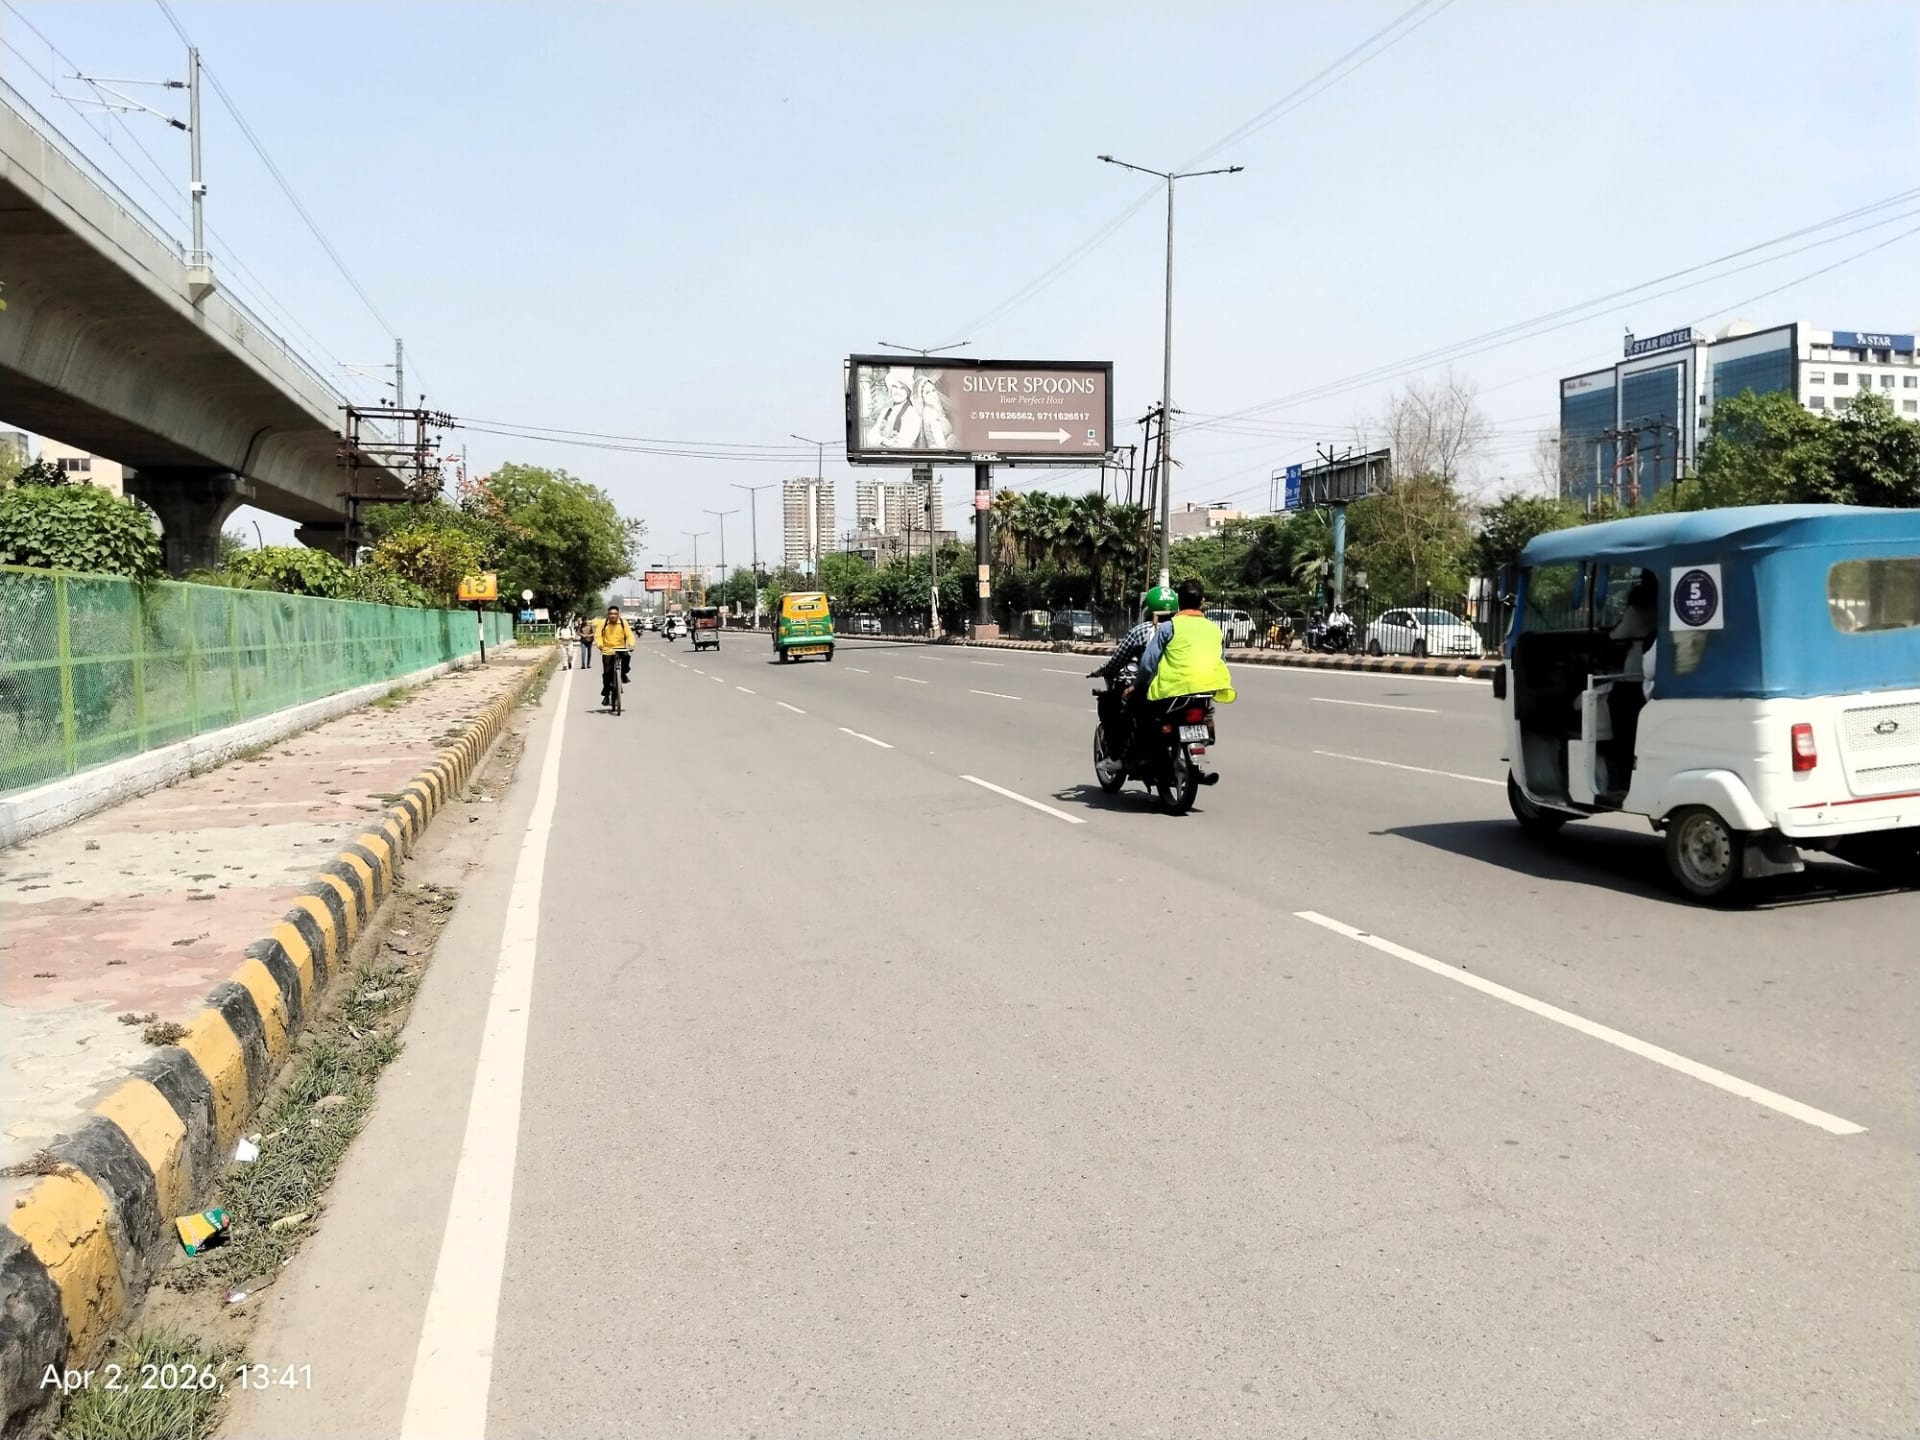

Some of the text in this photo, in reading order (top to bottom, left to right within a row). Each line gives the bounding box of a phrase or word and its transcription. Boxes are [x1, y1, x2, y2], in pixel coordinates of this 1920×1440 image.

[1634, 330, 1690, 353] STAR HOTEL
[1867, 335, 1891, 346] STAR
[963, 375, 1095, 394] SILVER SPOONS
[999, 395, 1064, 405] Your Perfect Host
[1690, 582, 1701, 599] 5
[1685, 599, 1707, 607] YEARS
